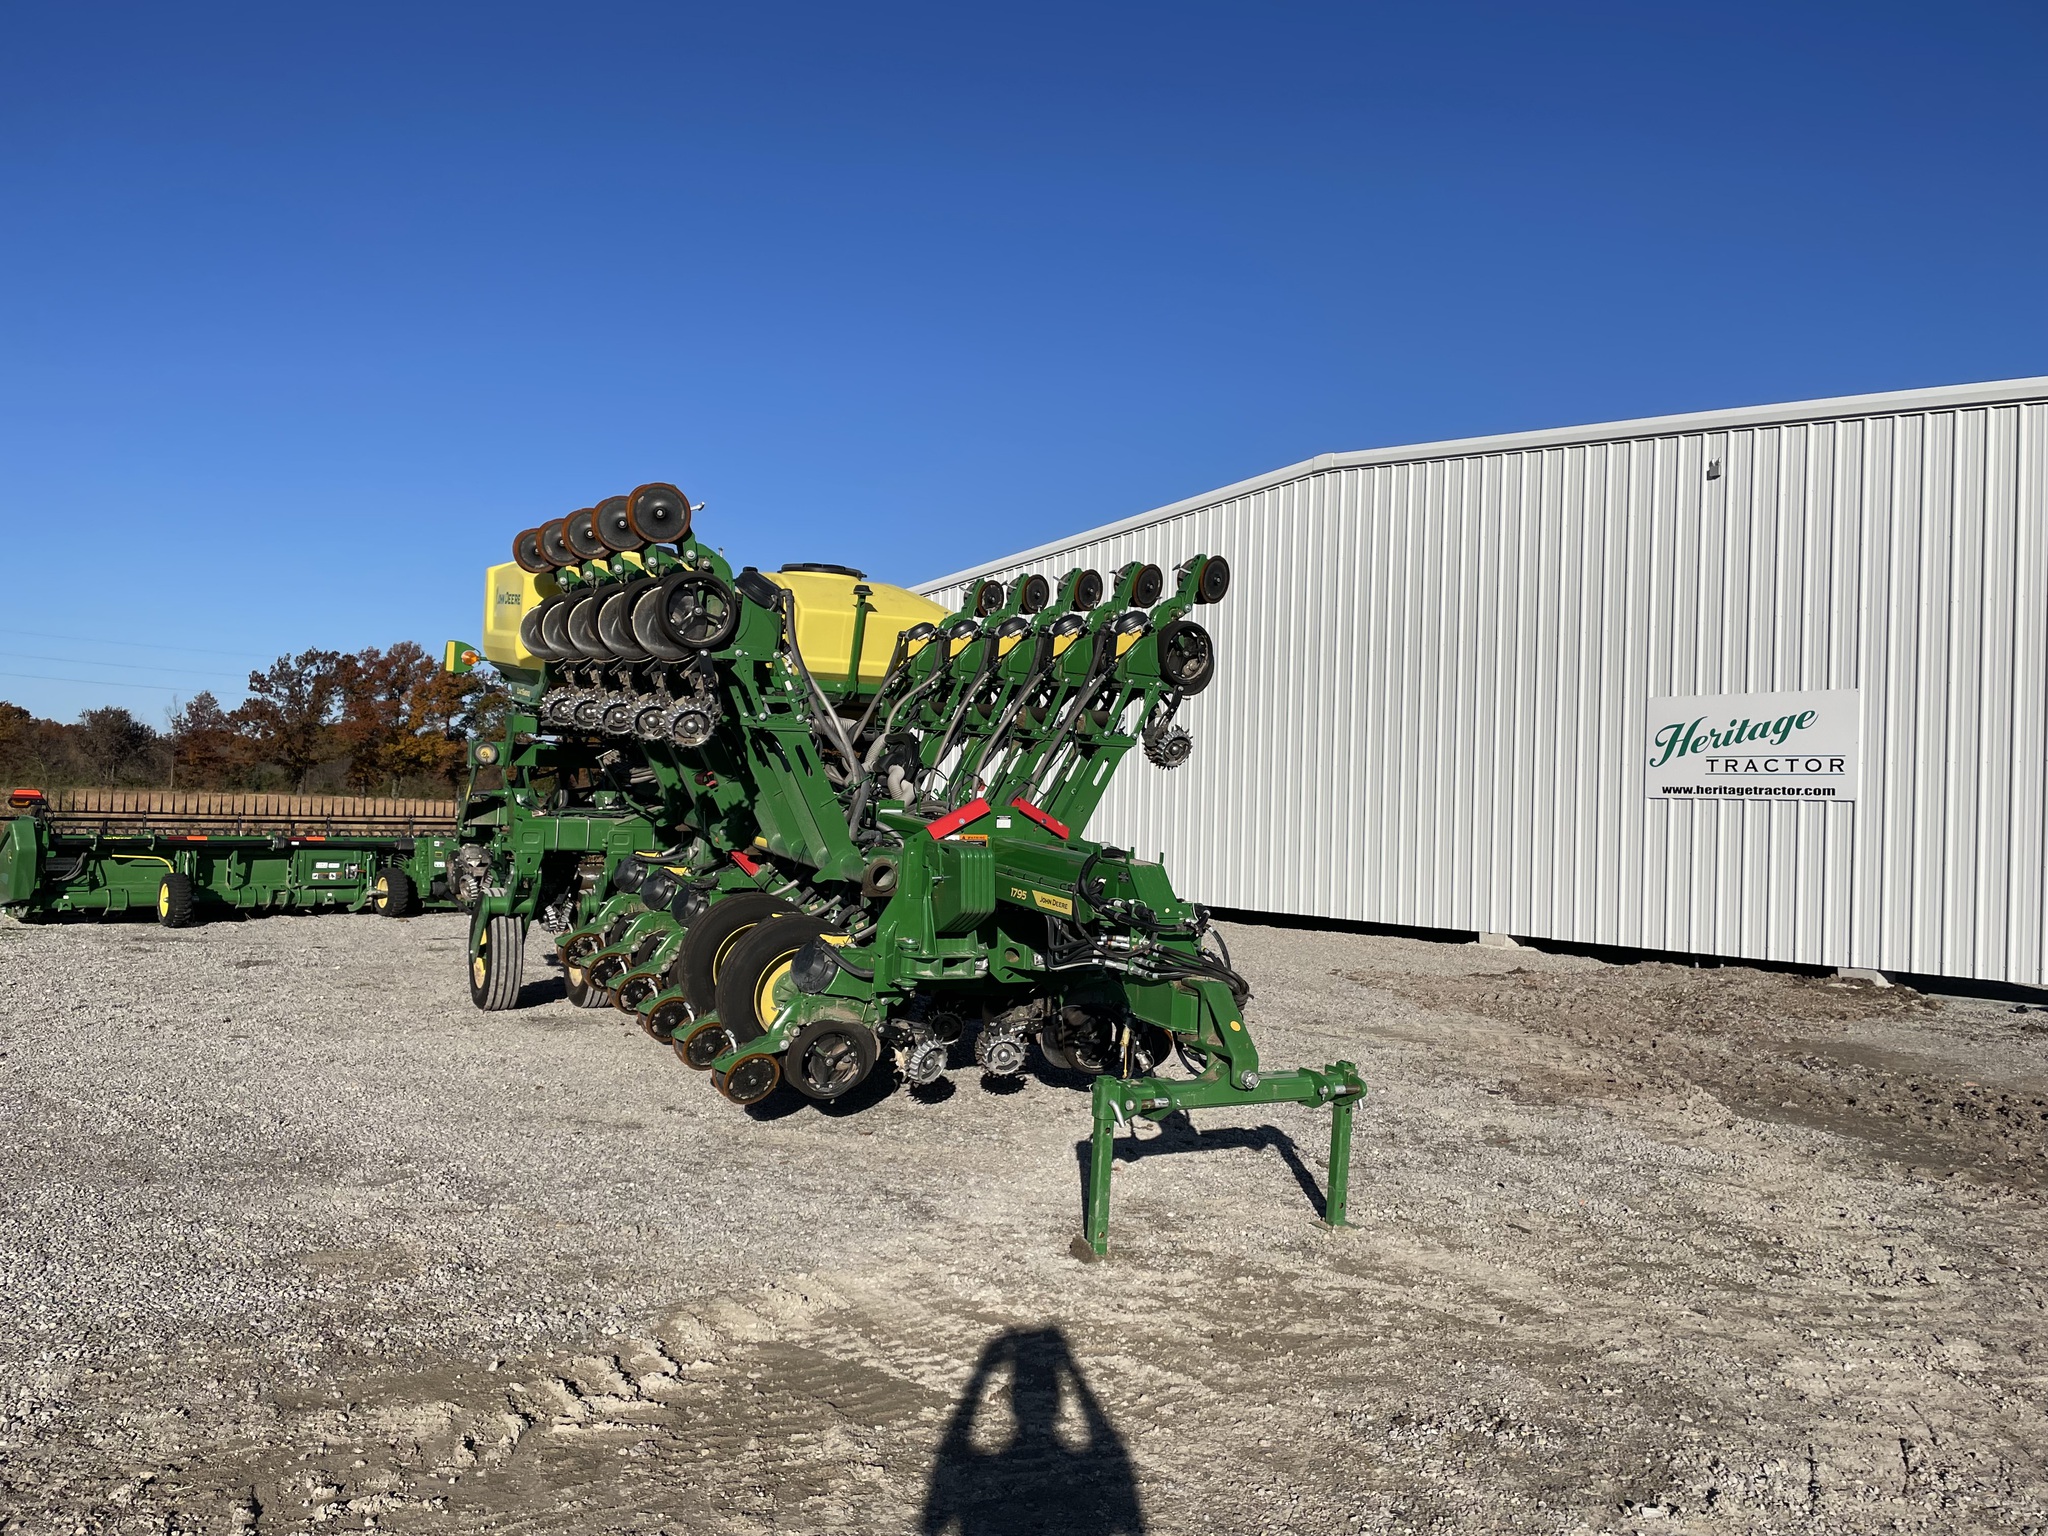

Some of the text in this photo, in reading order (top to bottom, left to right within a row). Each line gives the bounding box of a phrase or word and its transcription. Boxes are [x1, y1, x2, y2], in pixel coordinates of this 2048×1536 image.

[1649, 710, 1819, 767] Heritage
[1706, 758, 1845, 772] TRACTOR
[1662, 785, 1836, 796] www.heritagetractor.com
[1010, 887, 1028, 900] 1795
[1040, 896, 1068, 910] JOHN DEERE
